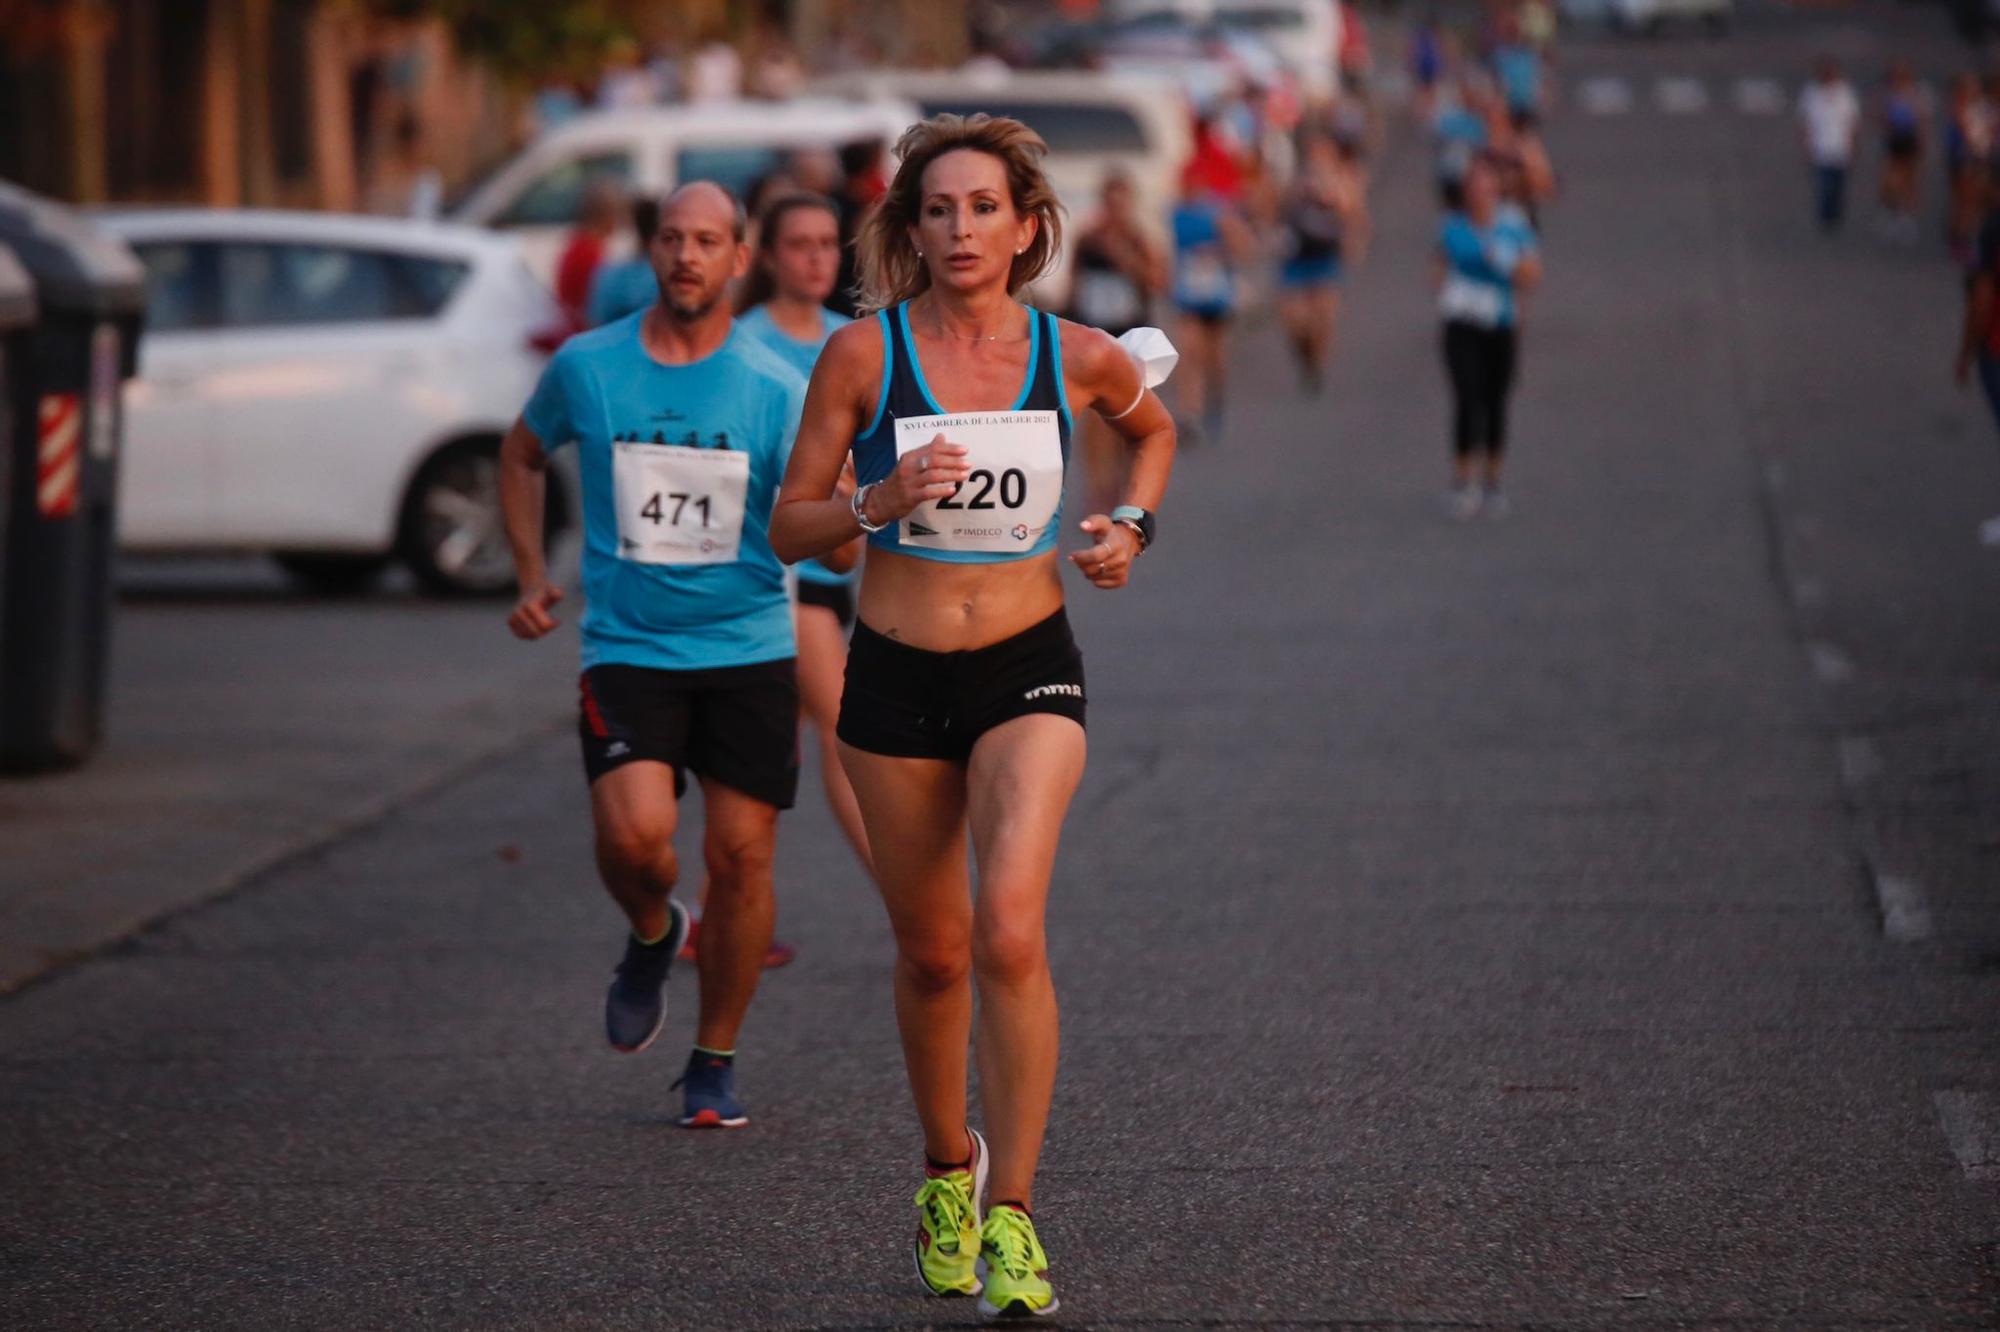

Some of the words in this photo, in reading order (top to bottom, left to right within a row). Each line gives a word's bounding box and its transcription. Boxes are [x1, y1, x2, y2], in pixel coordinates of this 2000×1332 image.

[904, 422, 921, 431] XVI
[922, 418, 969, 428] CARRERA
[971, 416, 983, 425] DE
[985, 416, 998, 425] LA
[1000, 415, 1032, 425] MUJER
[1033, 415, 1051, 424] 2021
[641, 491, 711, 528] 471
[963, 528, 1002, 536] IMDECO
